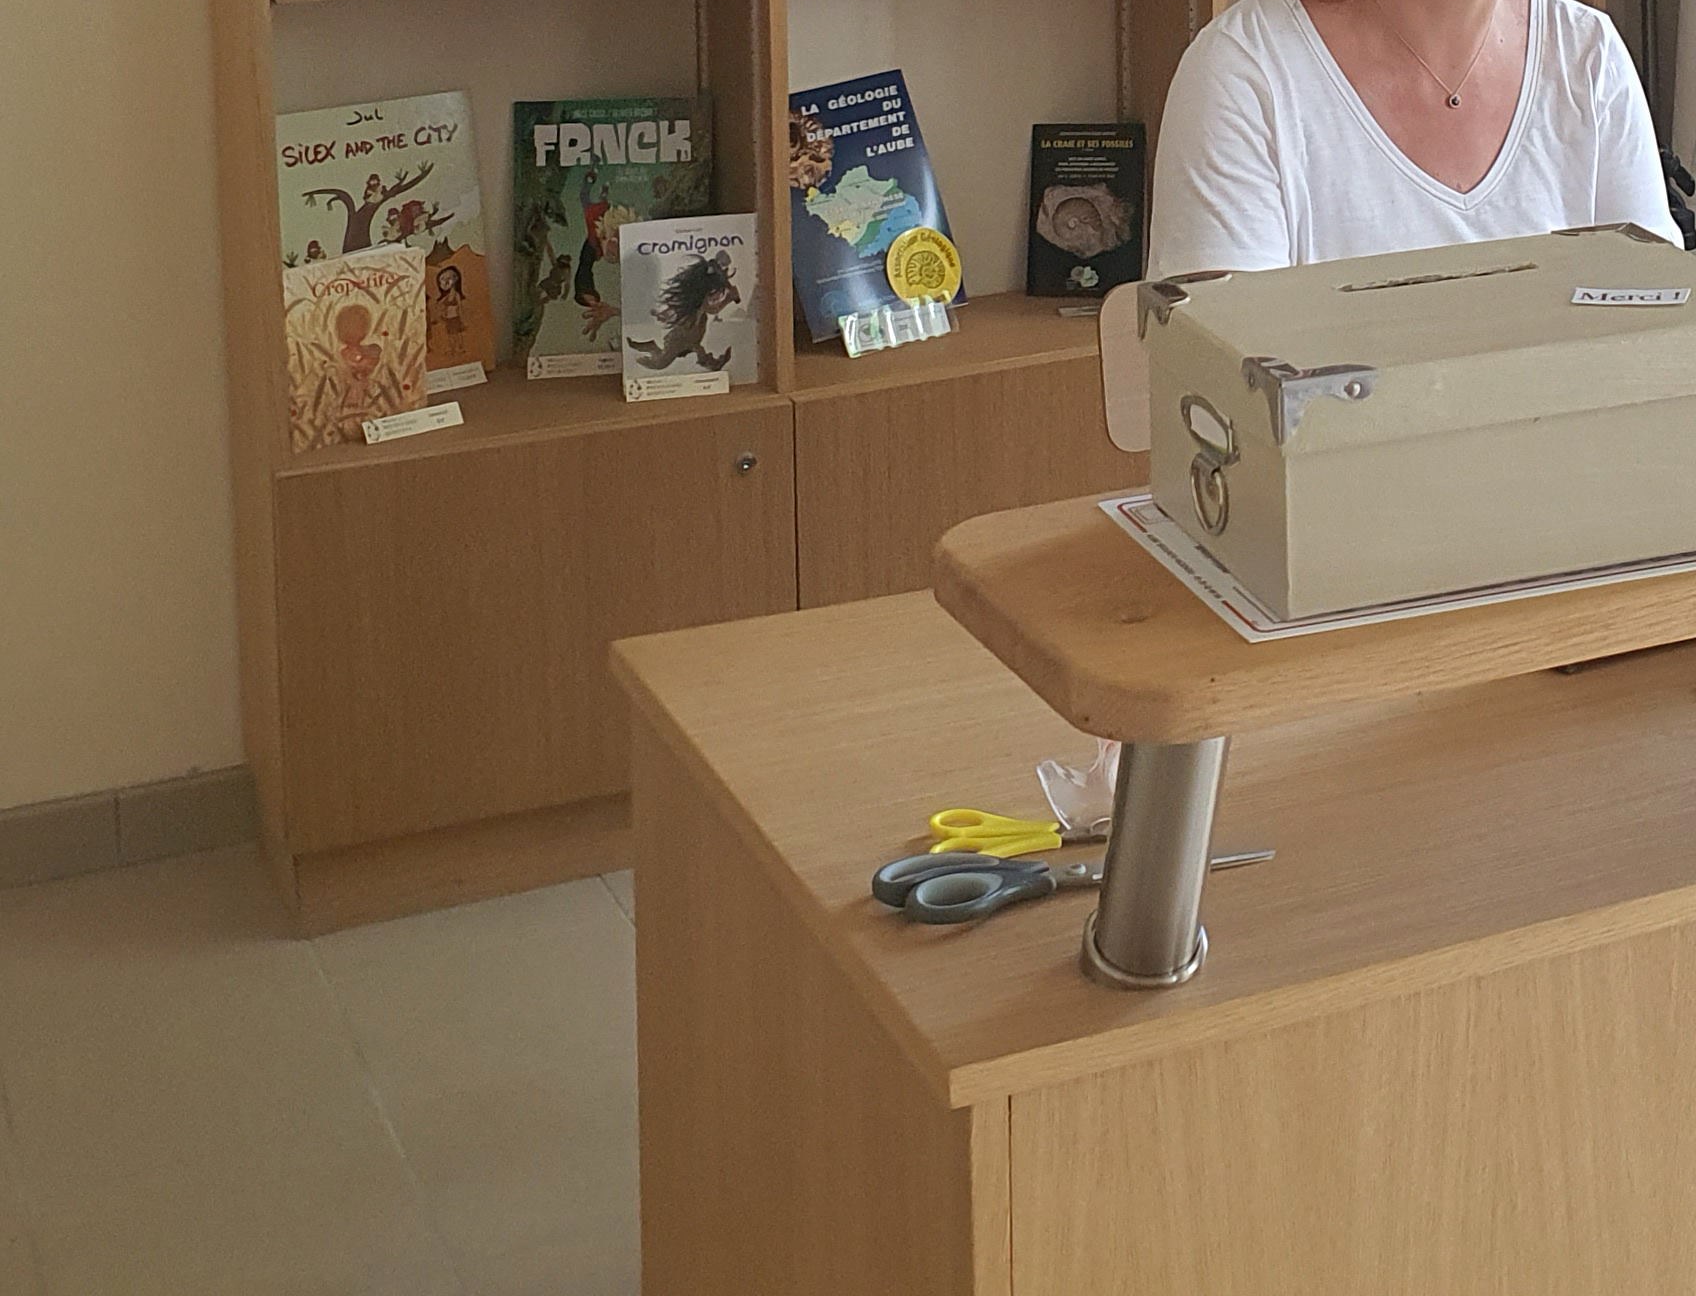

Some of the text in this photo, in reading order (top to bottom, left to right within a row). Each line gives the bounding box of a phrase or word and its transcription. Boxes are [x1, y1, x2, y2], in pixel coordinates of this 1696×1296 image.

[801, 85, 898, 116] LA GÉOLOGIE
[882, 98, 902, 111] DU
[346, 109, 384, 125] Jul
[806, 111, 906, 143] DÉPARTEMENT
[891, 124, 910, 137] DE
[345, 139, 374, 160] AND
[376, 132, 408, 152] THE
[534, 120, 692, 167] FRNCK
[866, 137, 914, 157] L'AUBE
[1041, 139, 1134, 148] LA CRAIE ET SES FOSSILES
[1579, 291, 1662, 302] Merci
